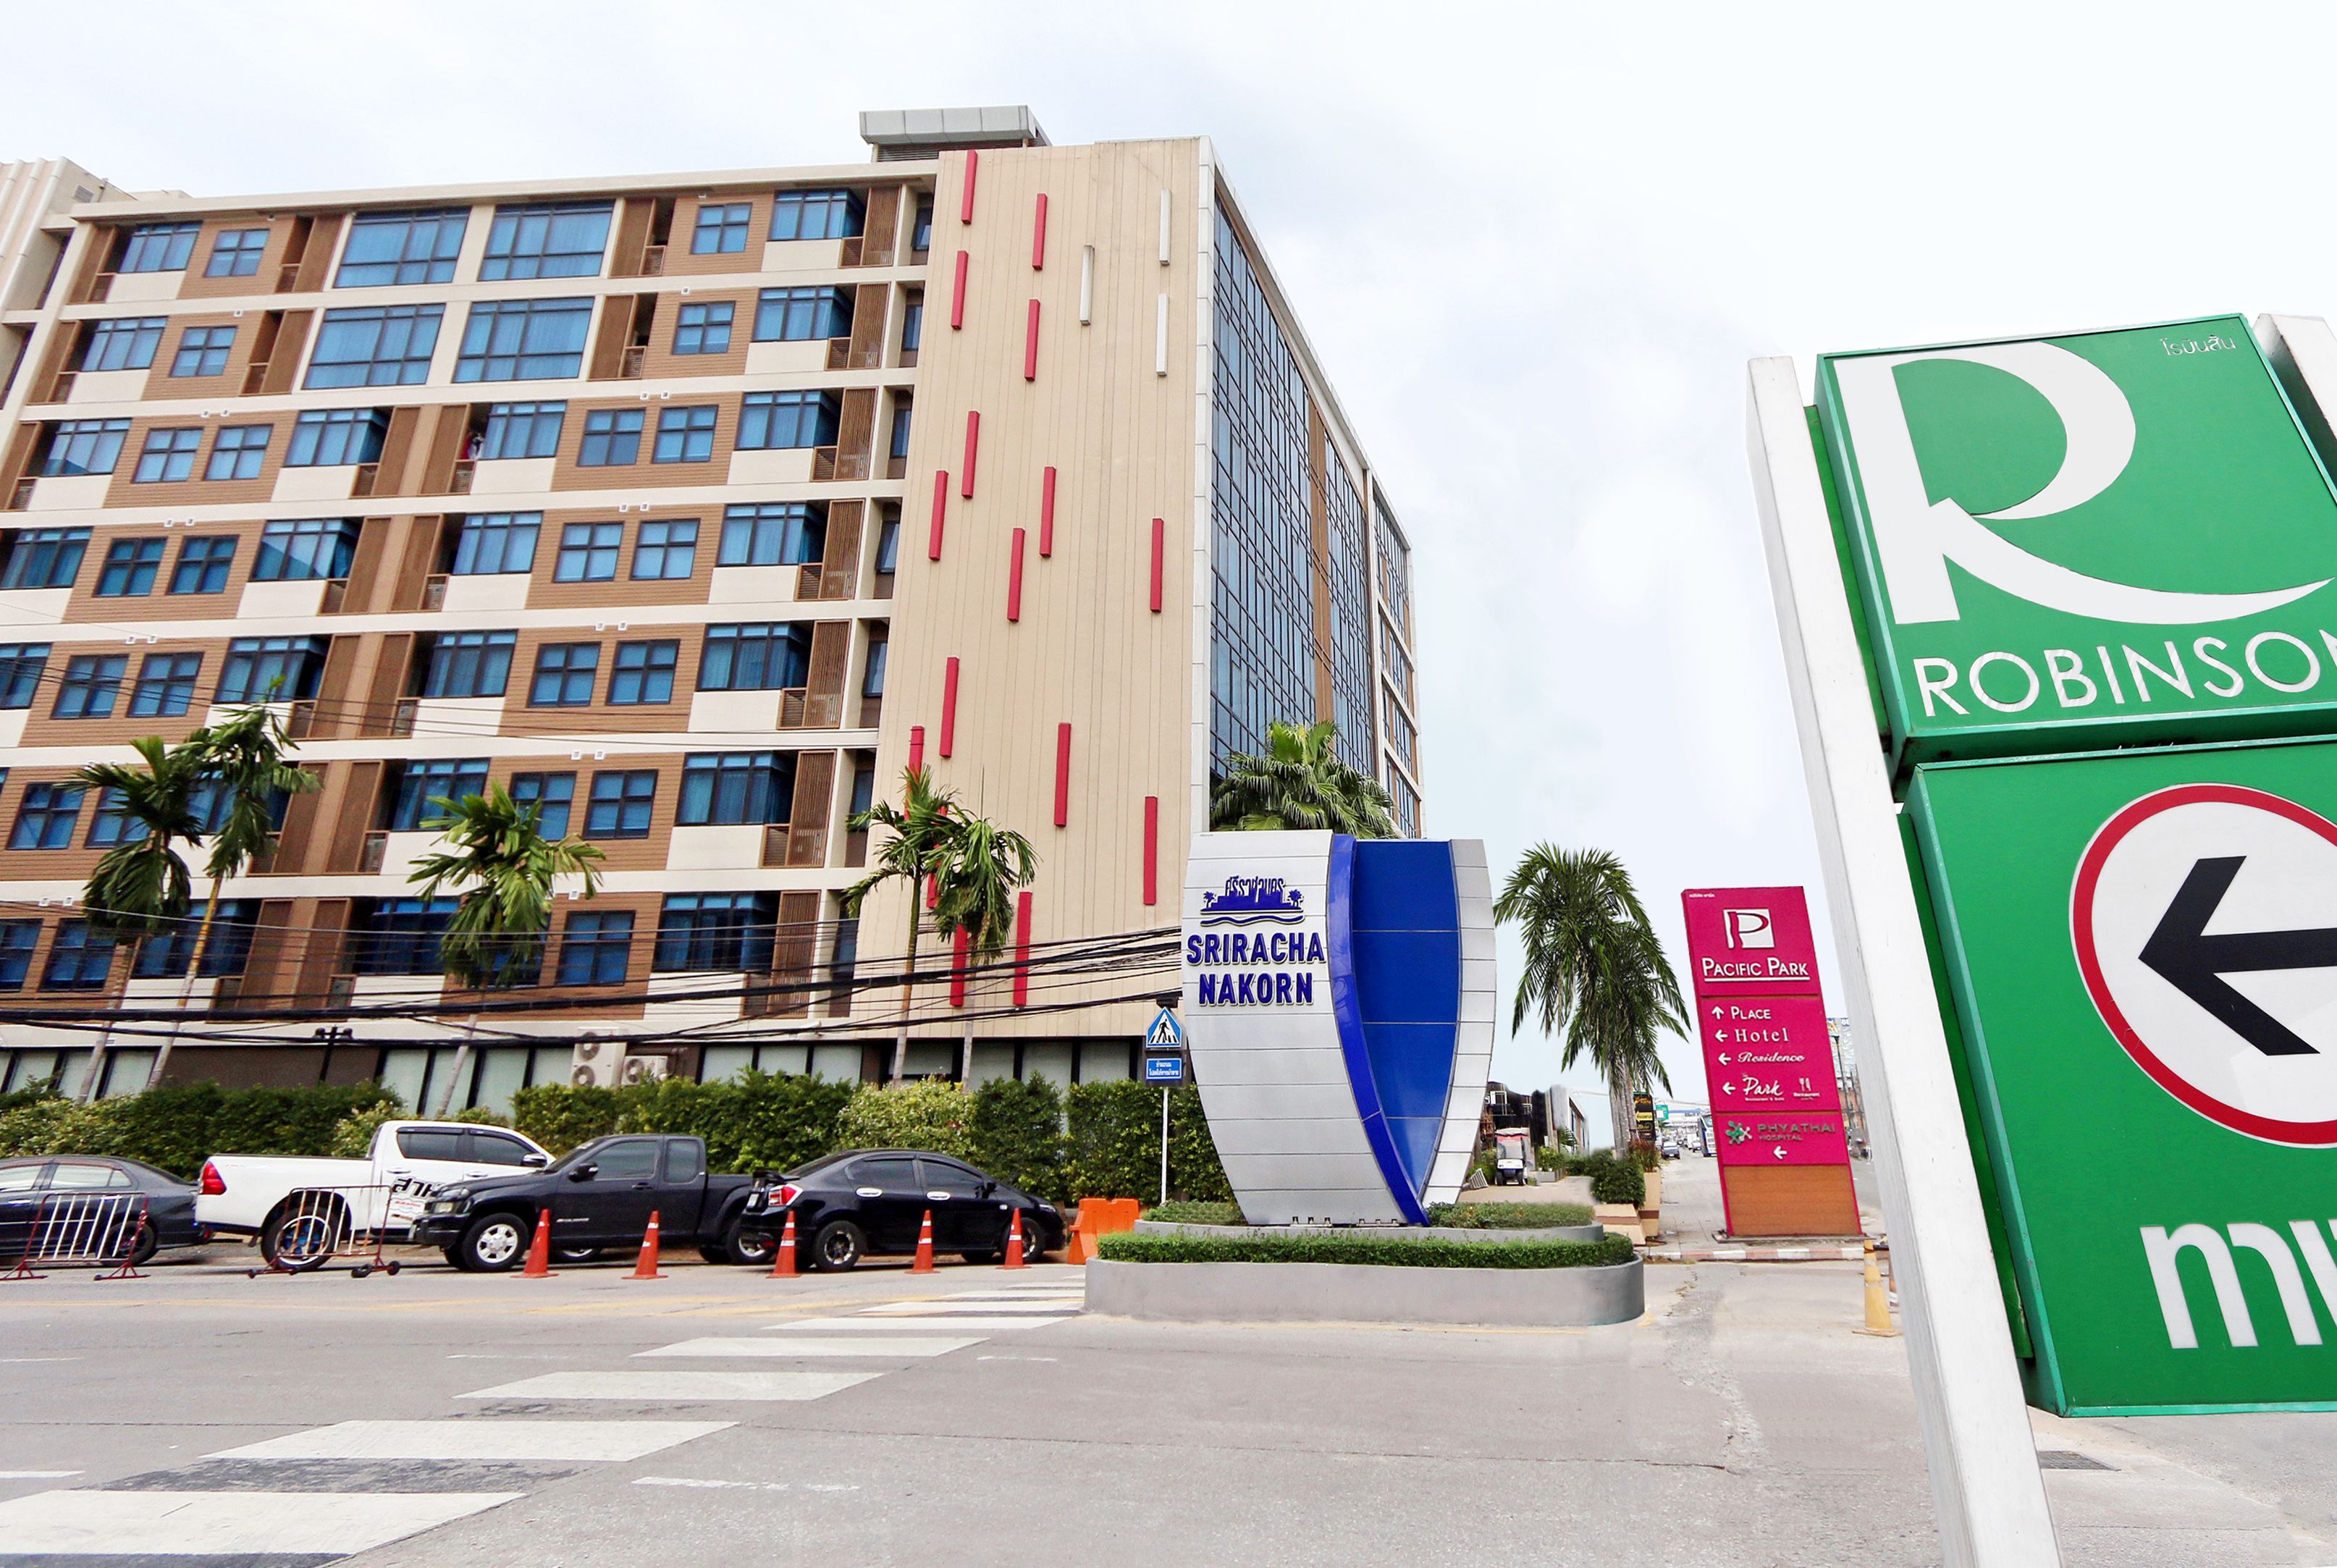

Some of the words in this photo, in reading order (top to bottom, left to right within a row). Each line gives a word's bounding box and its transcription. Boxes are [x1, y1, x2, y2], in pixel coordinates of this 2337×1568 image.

[1187, 932, 1326, 964] SRIRACHA
[1198, 972, 1313, 1007] NAKORN
[1735, 1027, 1789, 1042] Hotel
[1738, 1052, 1805, 1063] Residence
[1742, 1076, 1784, 1096] Park
[1758, 1124, 1836, 1133] PHYATHAI
